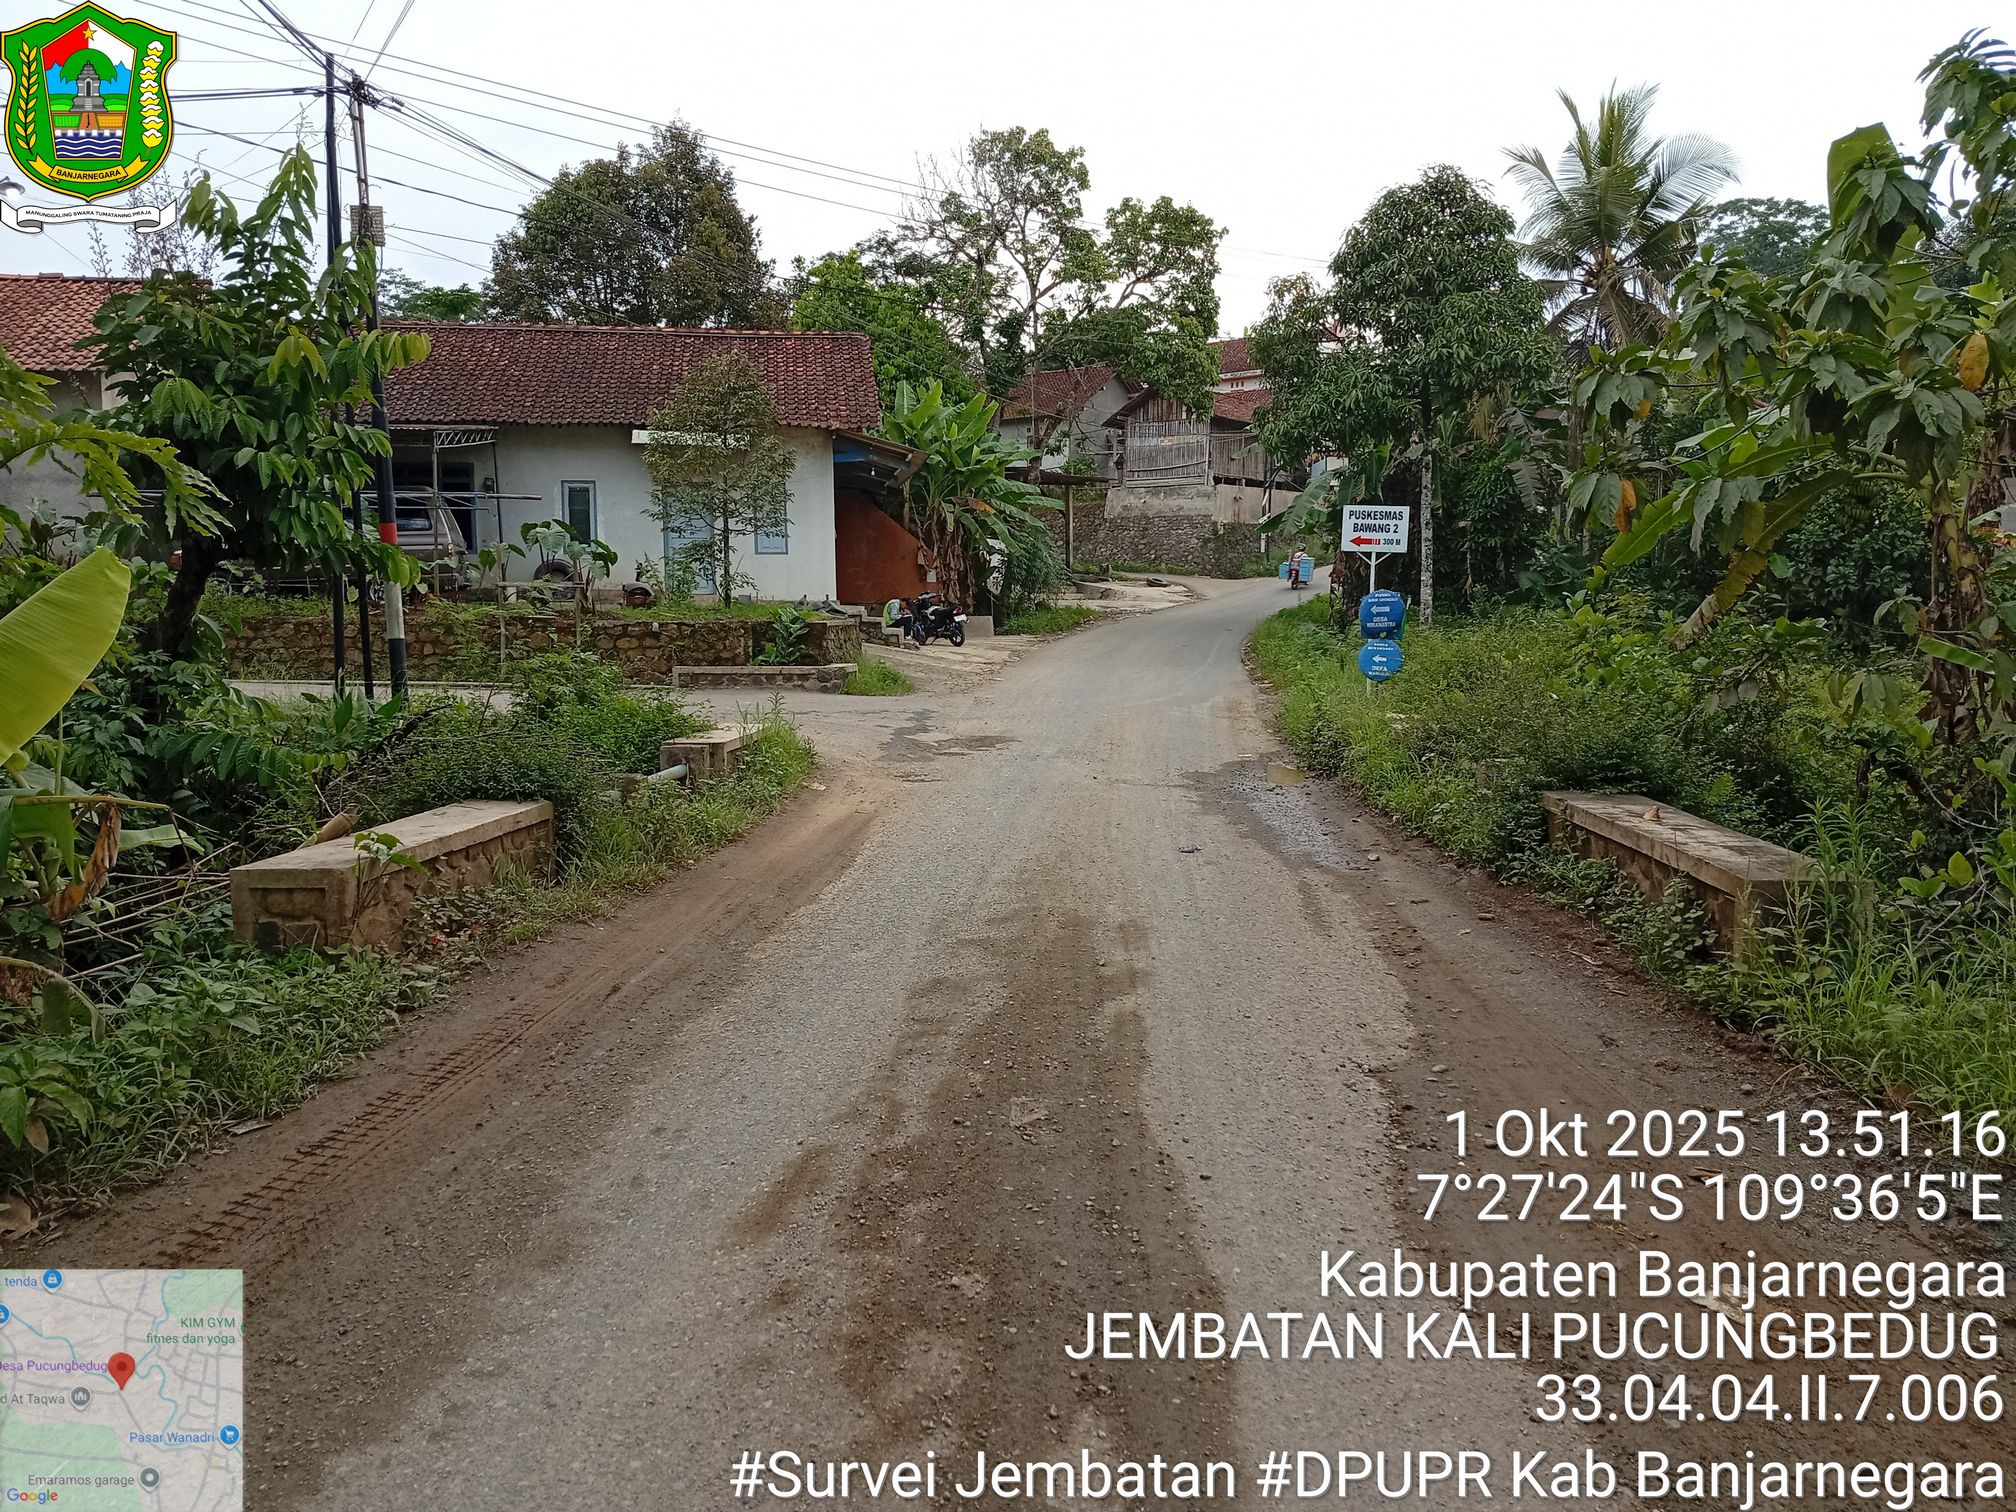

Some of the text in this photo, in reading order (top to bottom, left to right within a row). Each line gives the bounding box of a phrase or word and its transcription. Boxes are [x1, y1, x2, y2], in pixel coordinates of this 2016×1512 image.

[1348, 509, 1404, 521] PUSKESMAS
[1352, 522, 1399, 534] BAWANG 2
[1382, 537, 1401, 546] 300 M
